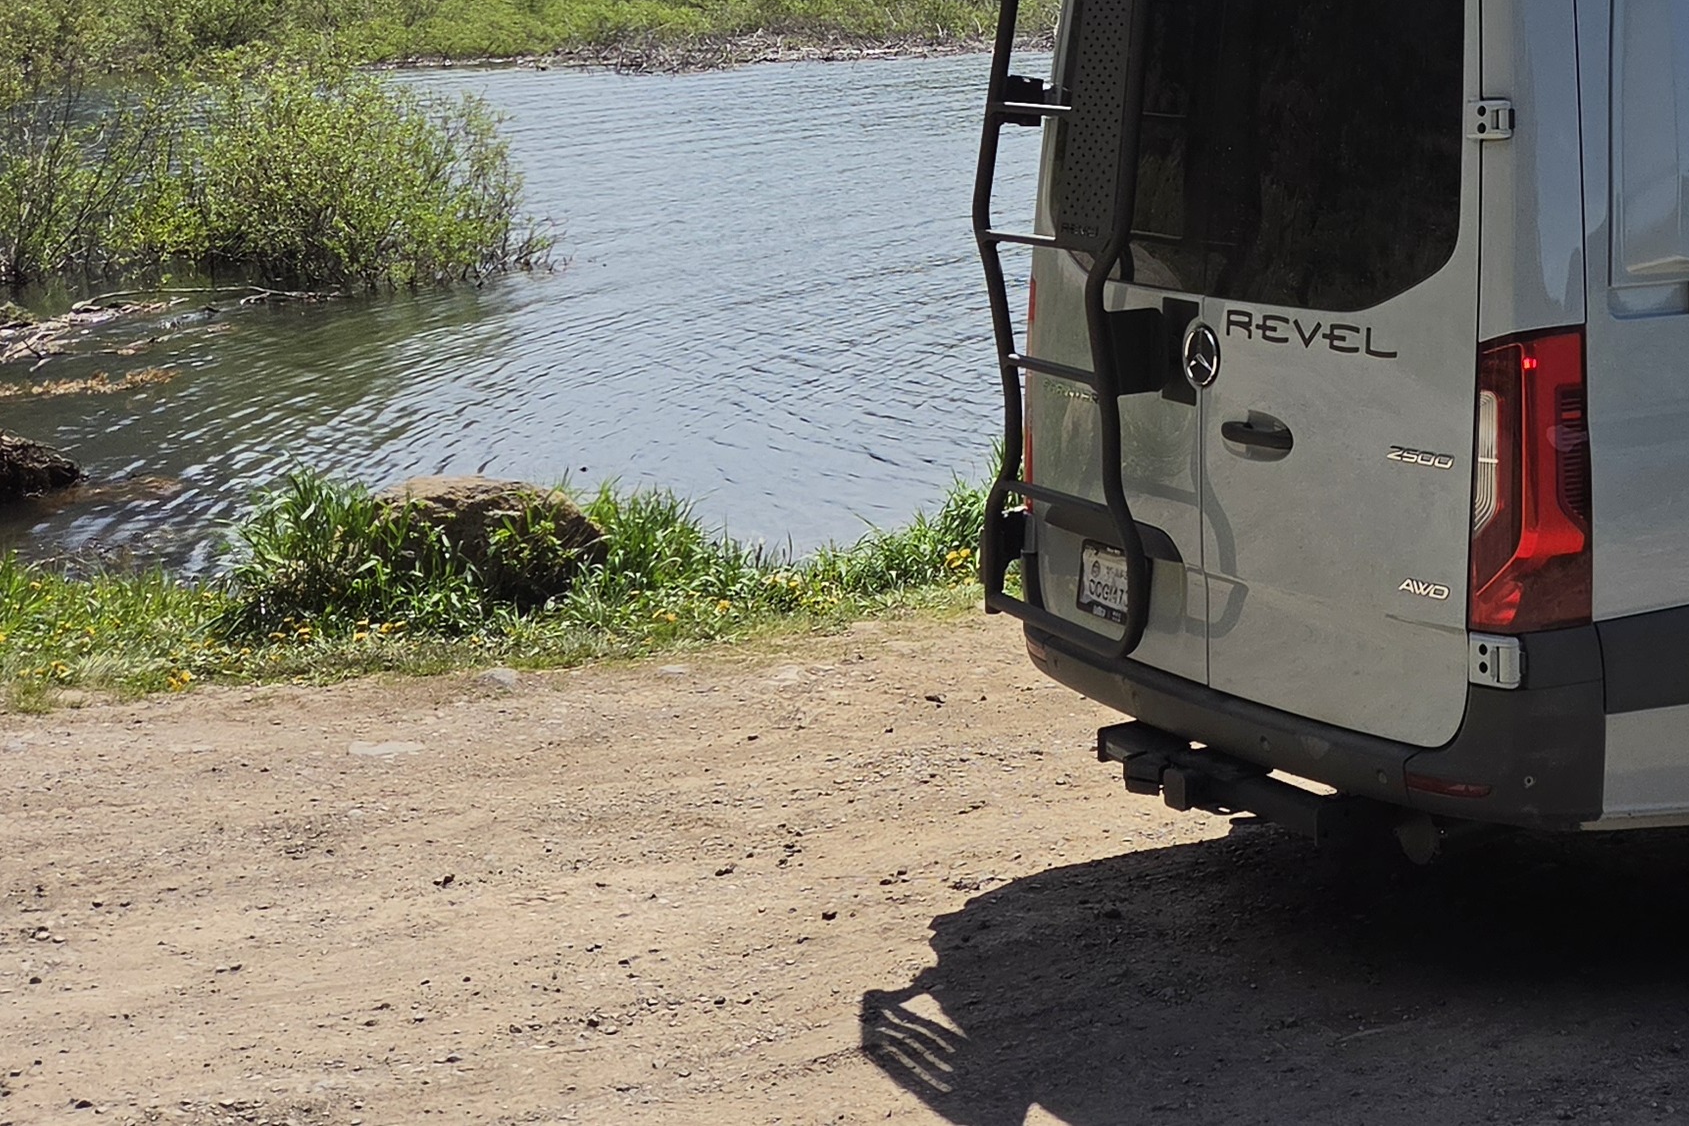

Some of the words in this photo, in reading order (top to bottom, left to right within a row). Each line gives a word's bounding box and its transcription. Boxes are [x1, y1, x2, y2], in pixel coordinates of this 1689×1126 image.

[1225, 309, 1398, 359] REVEL
[1386, 445, 1455, 470] 2500
[1398, 577, 1451, 601] AWD
